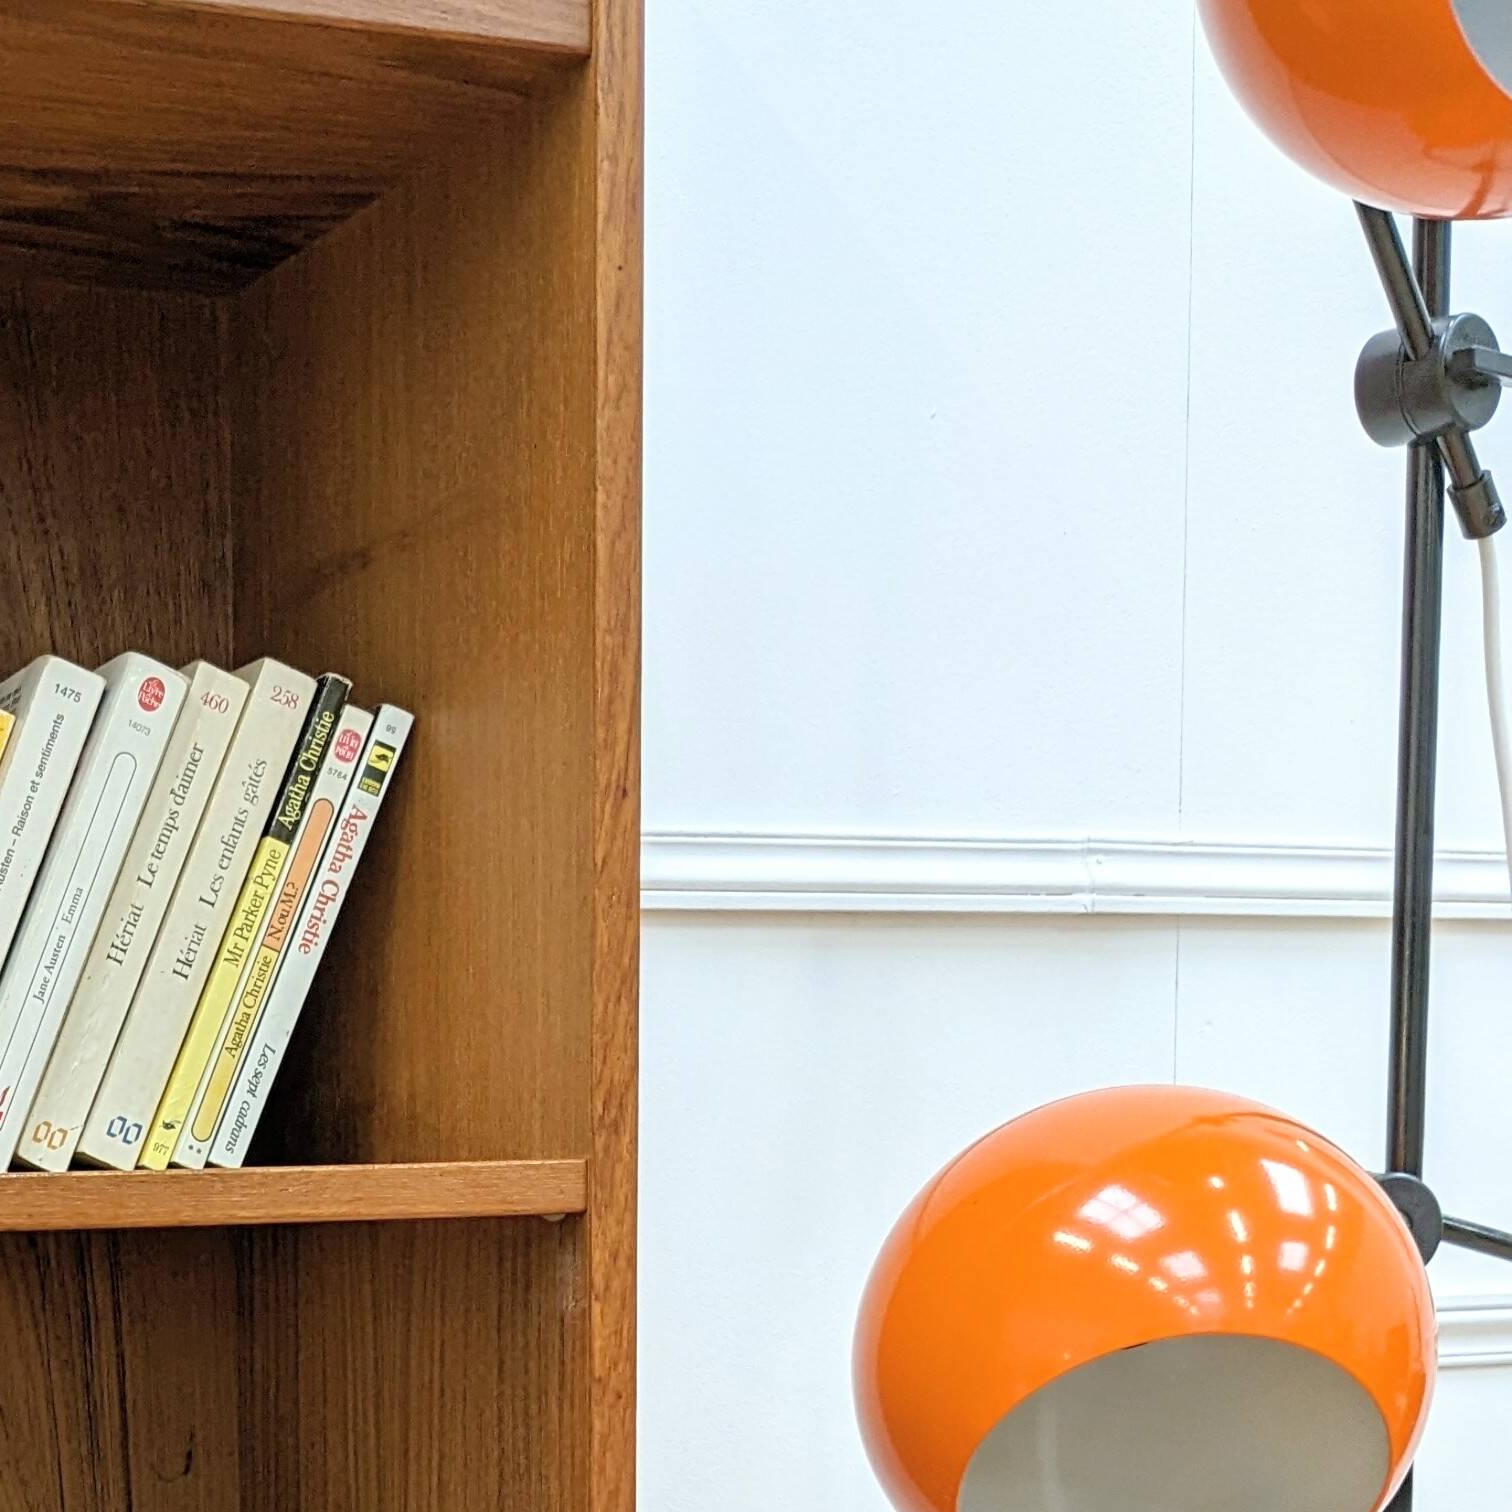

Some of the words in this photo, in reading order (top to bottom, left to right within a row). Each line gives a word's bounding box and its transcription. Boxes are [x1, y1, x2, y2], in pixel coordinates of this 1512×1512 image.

[53, 683, 82, 703] 1475
[200, 690, 229, 714] 460
[270, 686, 300, 710] 258
[12, 799, 32, 838] Raison
[29, 780, 40, 799] et
[35, 713, 66, 779] sentiments
[277, 776, 311, 830] Agatha
[298, 710, 335, 773] Christie
[106, 902, 144, 968] Hériat
[137, 861, 159, 889] Le
[150, 806, 180, 860] temps
[170, 742, 205, 807] d'aimer
[328, 804, 369, 874] Agatha
[173, 924, 208, 980] Hériat
[199, 873, 225, 909] Les
[219, 807, 249, 871] enfants
[243, 757, 268, 807] gâtés
[253, 848, 282, 890] Pyne
[233, 891, 265, 942] Parker
[298, 878, 340, 955] Christie
[32, 977, 51, 1004] Jane
[43, 934, 66, 977] Austen
[62, 886, 84, 924] Emma
[223, 943, 245, 968] Mr
[224, 1012, 252, 1059] Agatha
[242, 955, 272, 1010] Christie
[254, 1043, 276, 1070] Les
[247, 1069, 263, 1099] sept
[225, 1100, 250, 1154] cadrans
